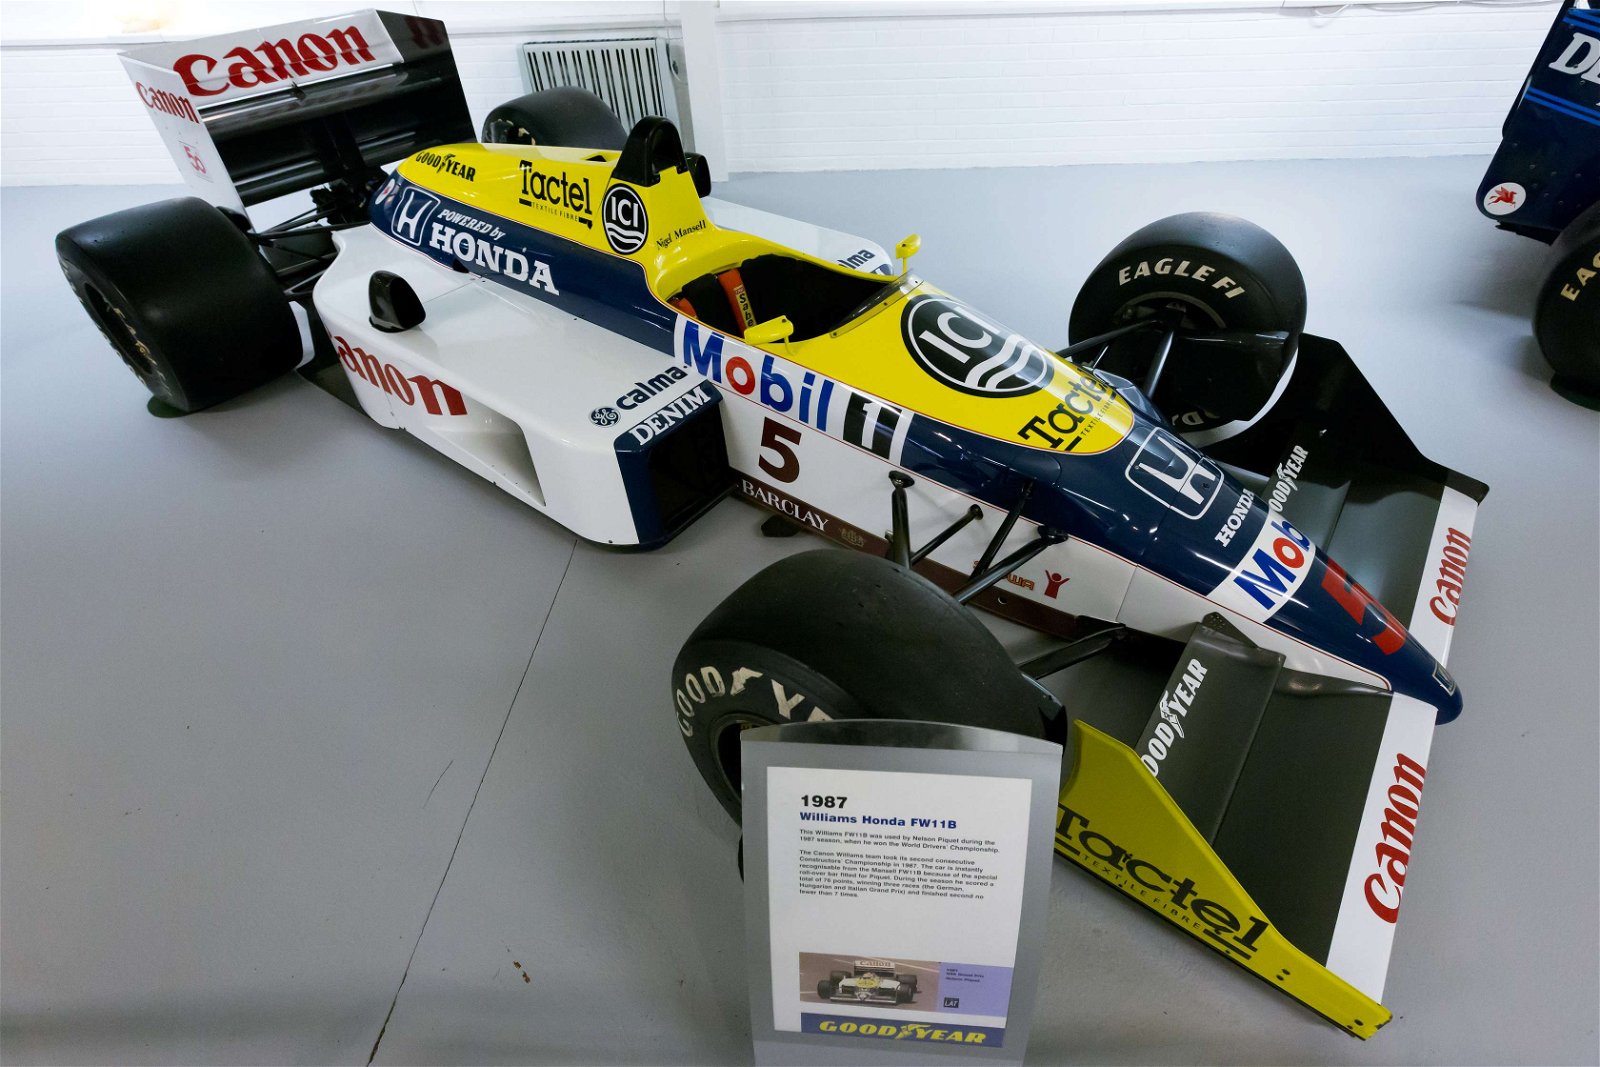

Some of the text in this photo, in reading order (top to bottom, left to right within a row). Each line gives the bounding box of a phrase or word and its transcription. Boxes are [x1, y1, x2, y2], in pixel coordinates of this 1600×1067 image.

[173, 25, 376, 96] Canon
[136, 81, 200, 124] Canon
[519, 160, 592, 215] Tactel
[611, 196, 639, 228] ICI
[437, 209, 506, 240] POWERED by
[656, 219, 706, 250] Nigel Mansell
[429, 222, 559, 296] HONDA
[837, 249, 876, 269] lma
[1119, 257, 1215, 286] EAGLE
[739, 293, 754, 327] Sabe
[919, 306, 1001, 364] ICI
[334, 336, 468, 416] anon
[616, 366, 688, 410] calma
[683, 320, 835, 432] Mobil
[628, 385, 711, 446] DENIM
[758, 417, 802, 484] 5
[1268, 445, 1309, 512] OODYEAR
[742, 479, 829, 532] BARCLAY
[1214, 488, 1255, 547] HONDA
[1233, 520, 1311, 610] Mob
[1430, 527, 1472, 626] Canon
[1141, 659, 1208, 777] OODYEAR
[800, 812, 957, 829] Williams Honda FW11B
[801, 795, 848, 809] 1987
[845, 859, 892, 867] Championship
[1364, 753, 1426, 923] Canon
[1056, 803, 1269, 953] Tactel
[1084, 853, 1202, 929] TEXTILE FIBRE
